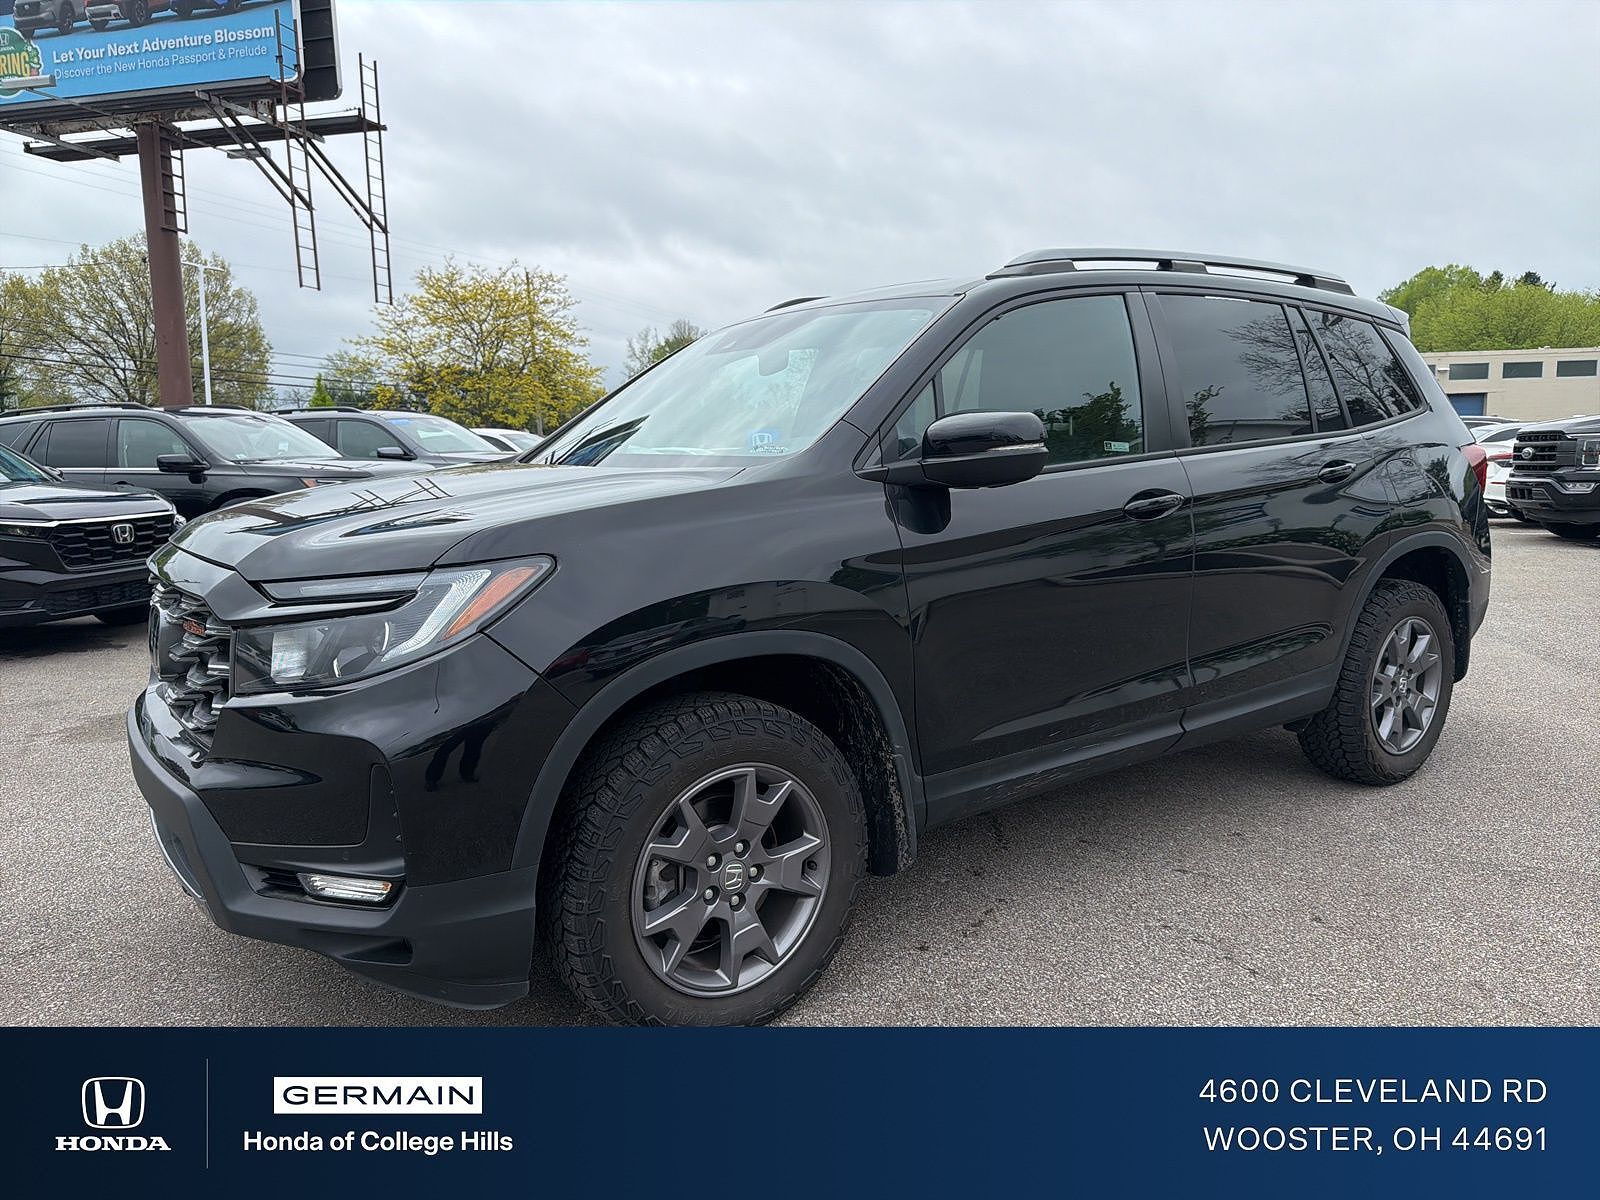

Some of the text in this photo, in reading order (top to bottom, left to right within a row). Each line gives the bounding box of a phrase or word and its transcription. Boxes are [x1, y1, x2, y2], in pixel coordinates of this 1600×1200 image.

[53, 26, 275, 63] Let Your Next Adventure Blossom
[55, 45, 267, 80] Discover the New Honda Passport & Prelude
